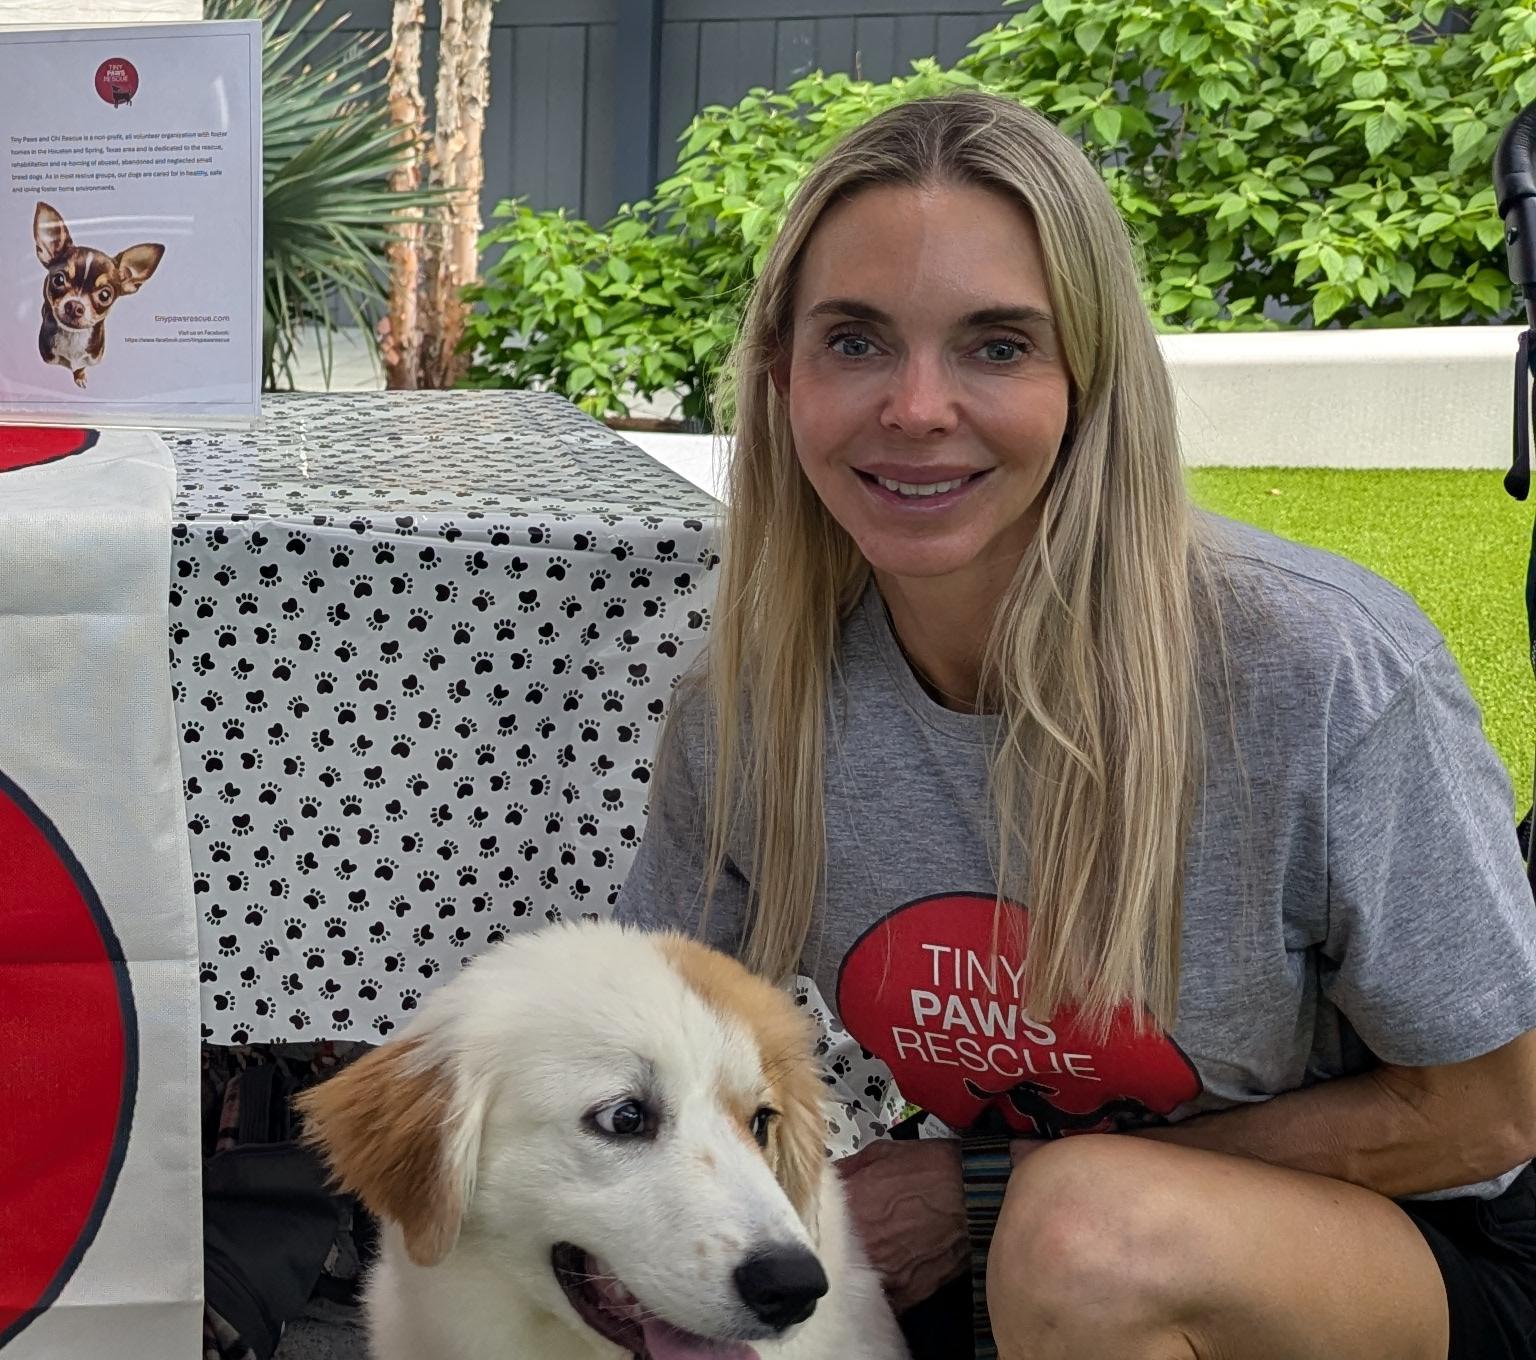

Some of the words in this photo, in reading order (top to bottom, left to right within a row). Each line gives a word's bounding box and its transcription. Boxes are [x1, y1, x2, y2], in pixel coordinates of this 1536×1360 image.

[921, 943, 1025, 999] TINY
[910, 989, 1057, 1046] PAWS
[891, 1026, 1102, 1082] RESCUE
